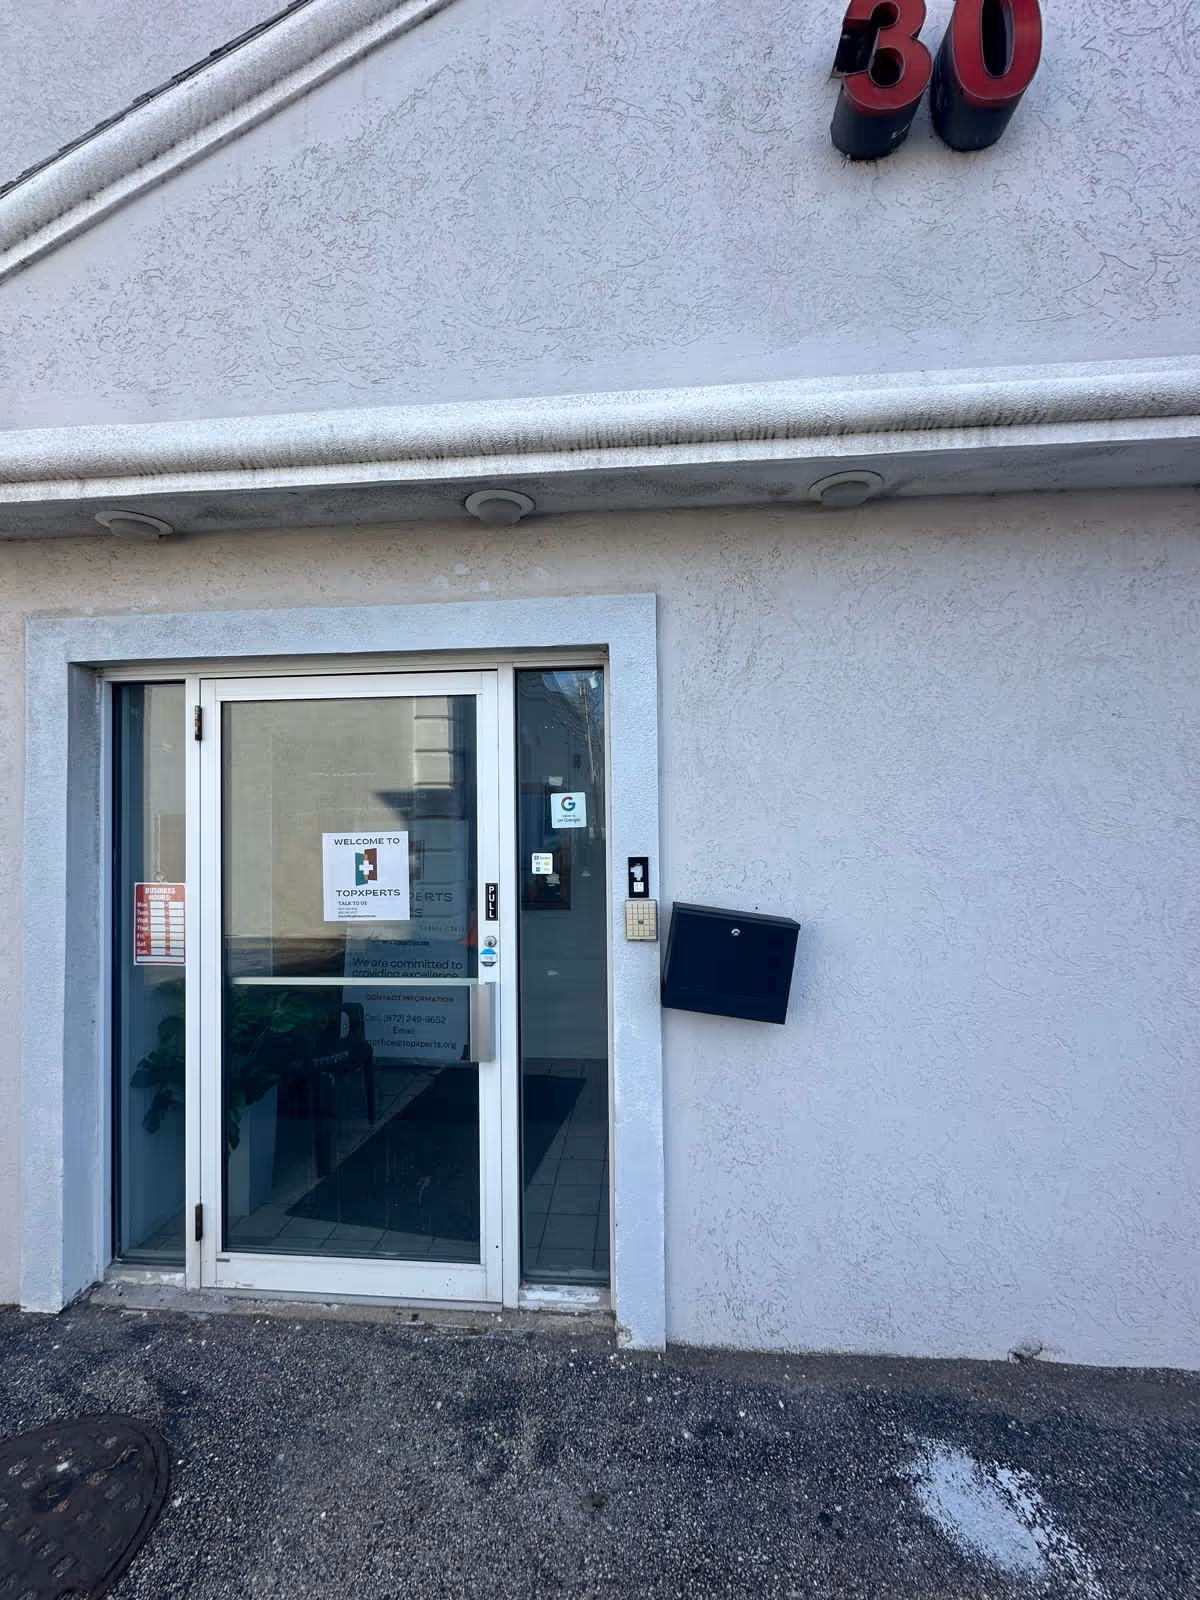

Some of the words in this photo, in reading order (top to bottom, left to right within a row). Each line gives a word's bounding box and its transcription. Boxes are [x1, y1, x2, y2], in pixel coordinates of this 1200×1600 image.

[833, 0, 1043, 112] 30
[334, 838, 384, 846] WELCOME
[386, 837, 400, 845] TO
[335, 889, 401, 897] TOPXPERTS
[353, 958, 370, 968] We
[370, 960, 388, 968] are
[390, 959, 449, 970] committed
[451, 961, 463, 970] to
